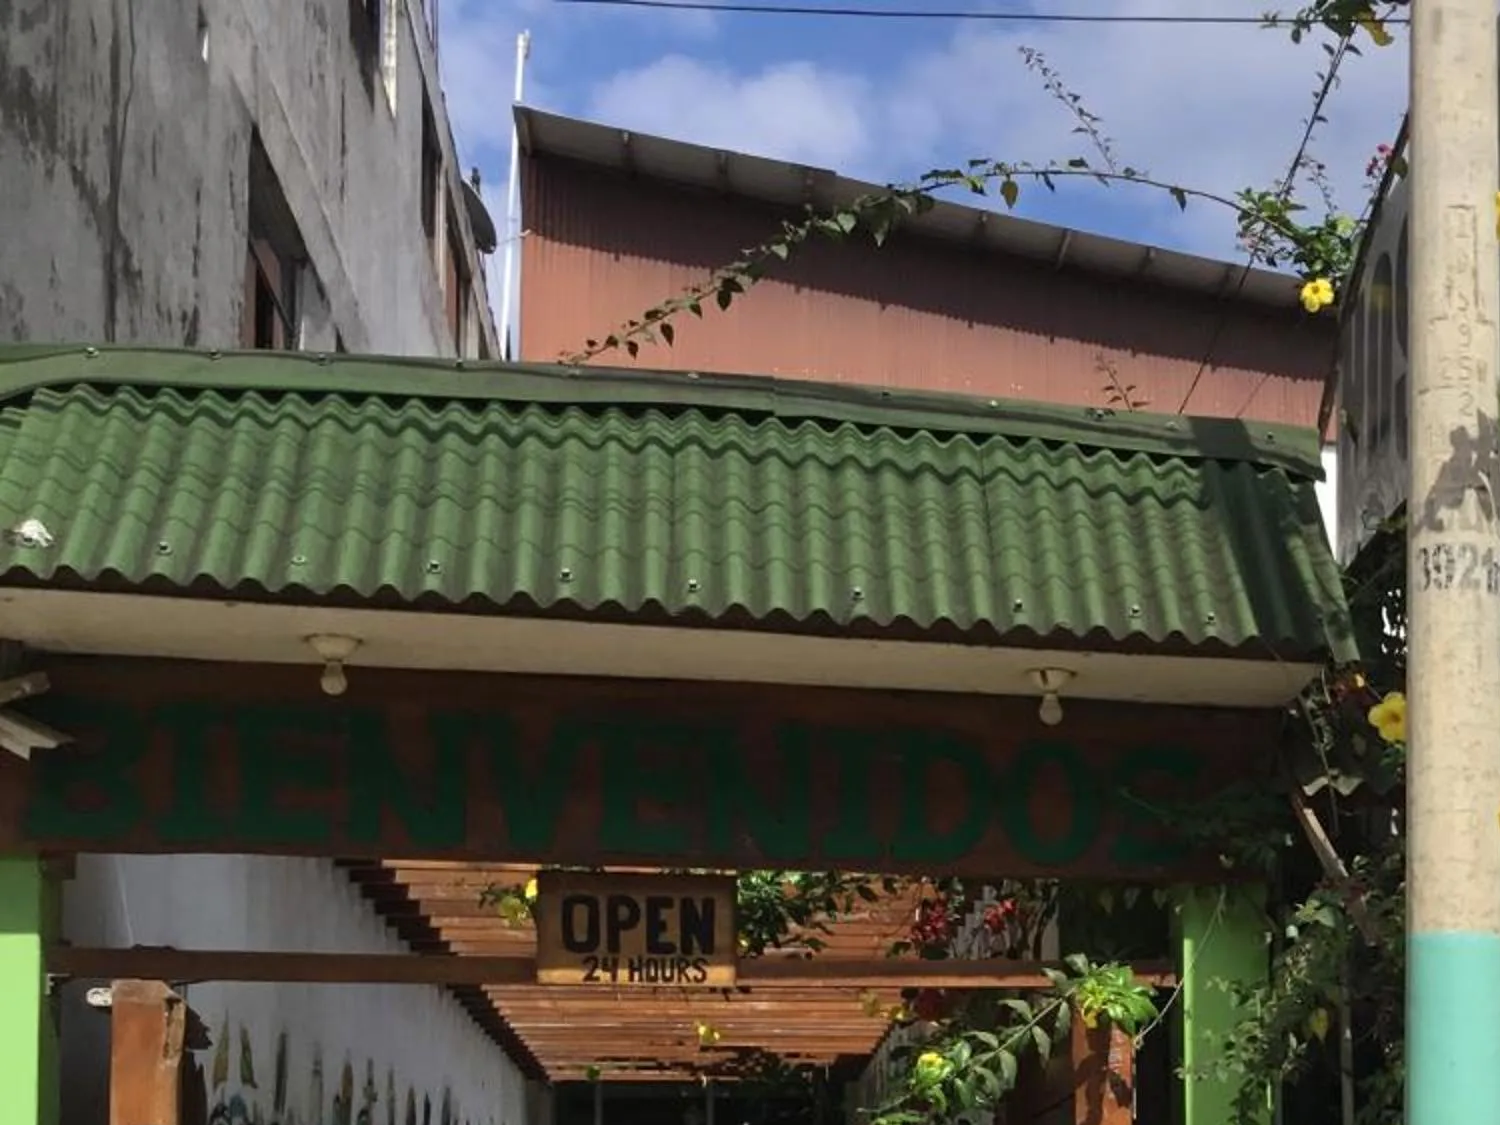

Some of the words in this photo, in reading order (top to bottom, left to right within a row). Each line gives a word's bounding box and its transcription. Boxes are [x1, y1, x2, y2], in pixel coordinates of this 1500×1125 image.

[24, 696, 1206, 868] BIENVENIDOS
[561, 893, 716, 955] OPEN
[582, 955, 620, 983] 24
[628, 955, 709, 984] HOURS
